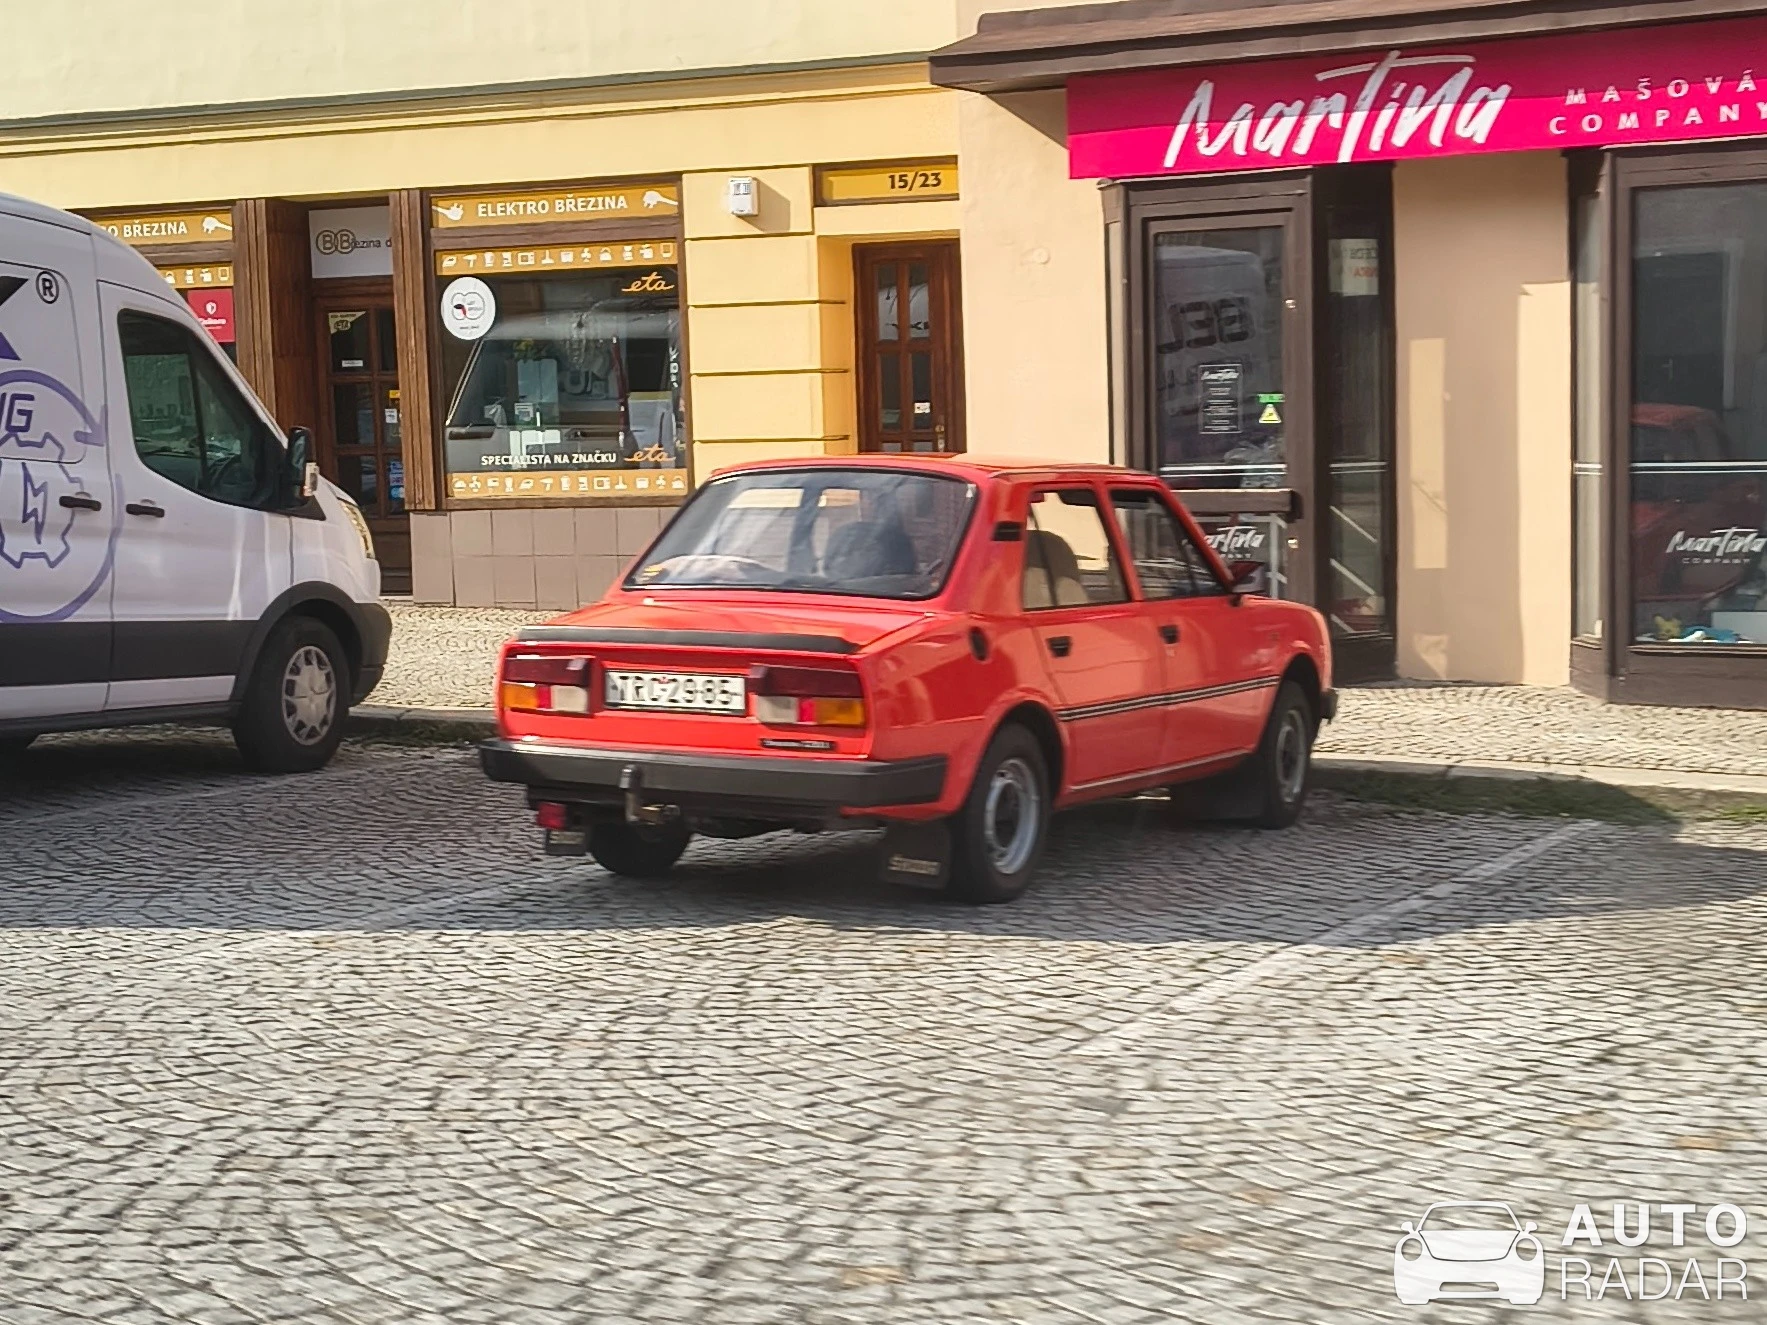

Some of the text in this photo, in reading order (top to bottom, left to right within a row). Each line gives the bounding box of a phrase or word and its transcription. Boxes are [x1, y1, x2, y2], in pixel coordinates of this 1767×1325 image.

[1565, 69, 1757, 106] MAŠOVÁ
[1163, 49, 1512, 168] Martina
[888, 170, 942, 192] 15/23
[477, 193, 628, 218] ELEKTRO BŘEZINA
[123, 220, 188, 238] BŘEZINA
[621, 272, 675, 293] eta
[481, 444, 677, 466] SPECIALISTA NA ZNAČKU eta
